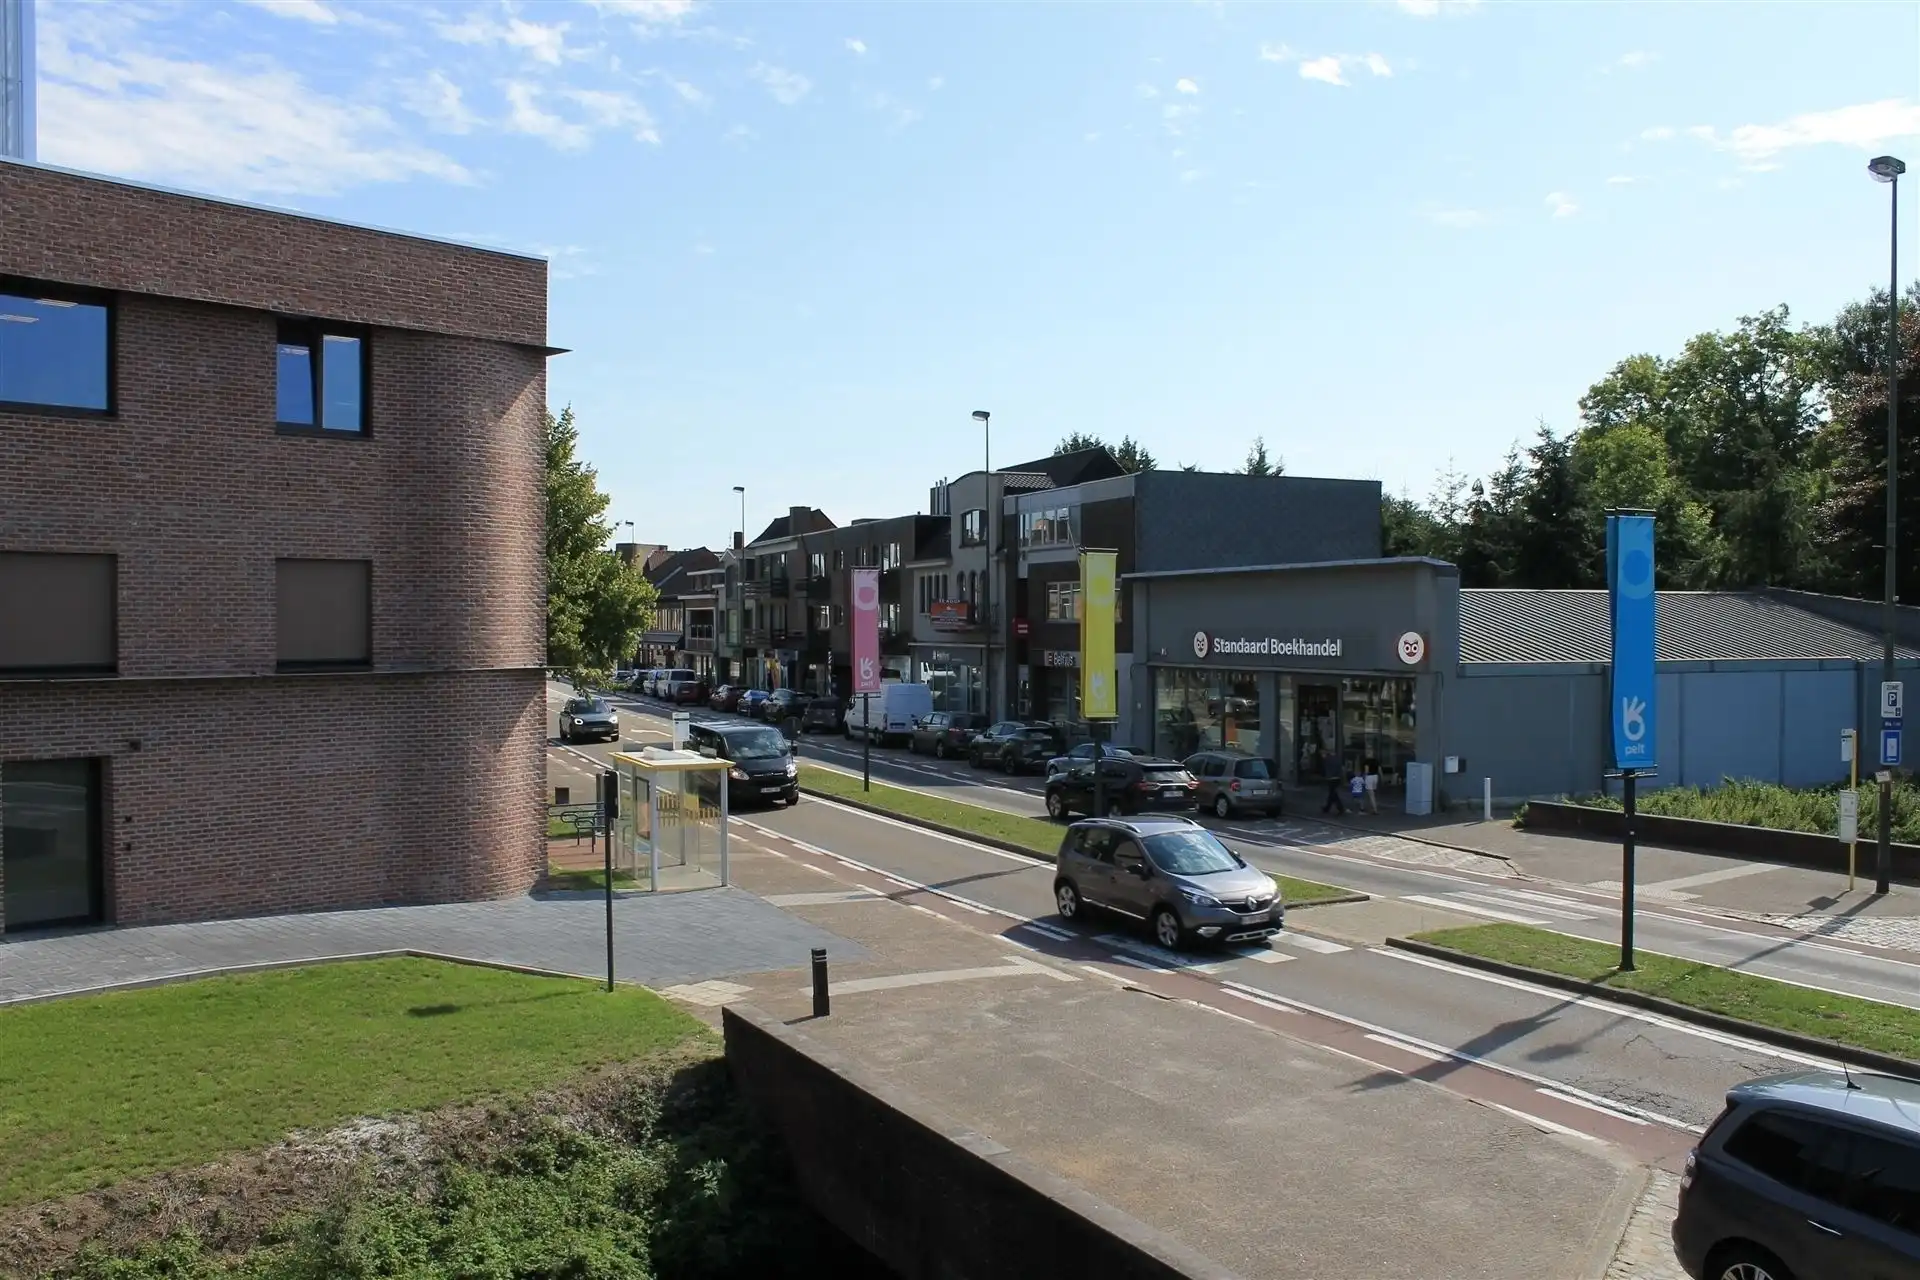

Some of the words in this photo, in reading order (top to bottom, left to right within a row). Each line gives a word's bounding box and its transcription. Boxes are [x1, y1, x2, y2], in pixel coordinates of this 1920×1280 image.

[1213, 637, 1268, 653] Standaard
[1270, 638, 1342, 656] Boekhandel
[1625, 742, 1645, 756] pelt
